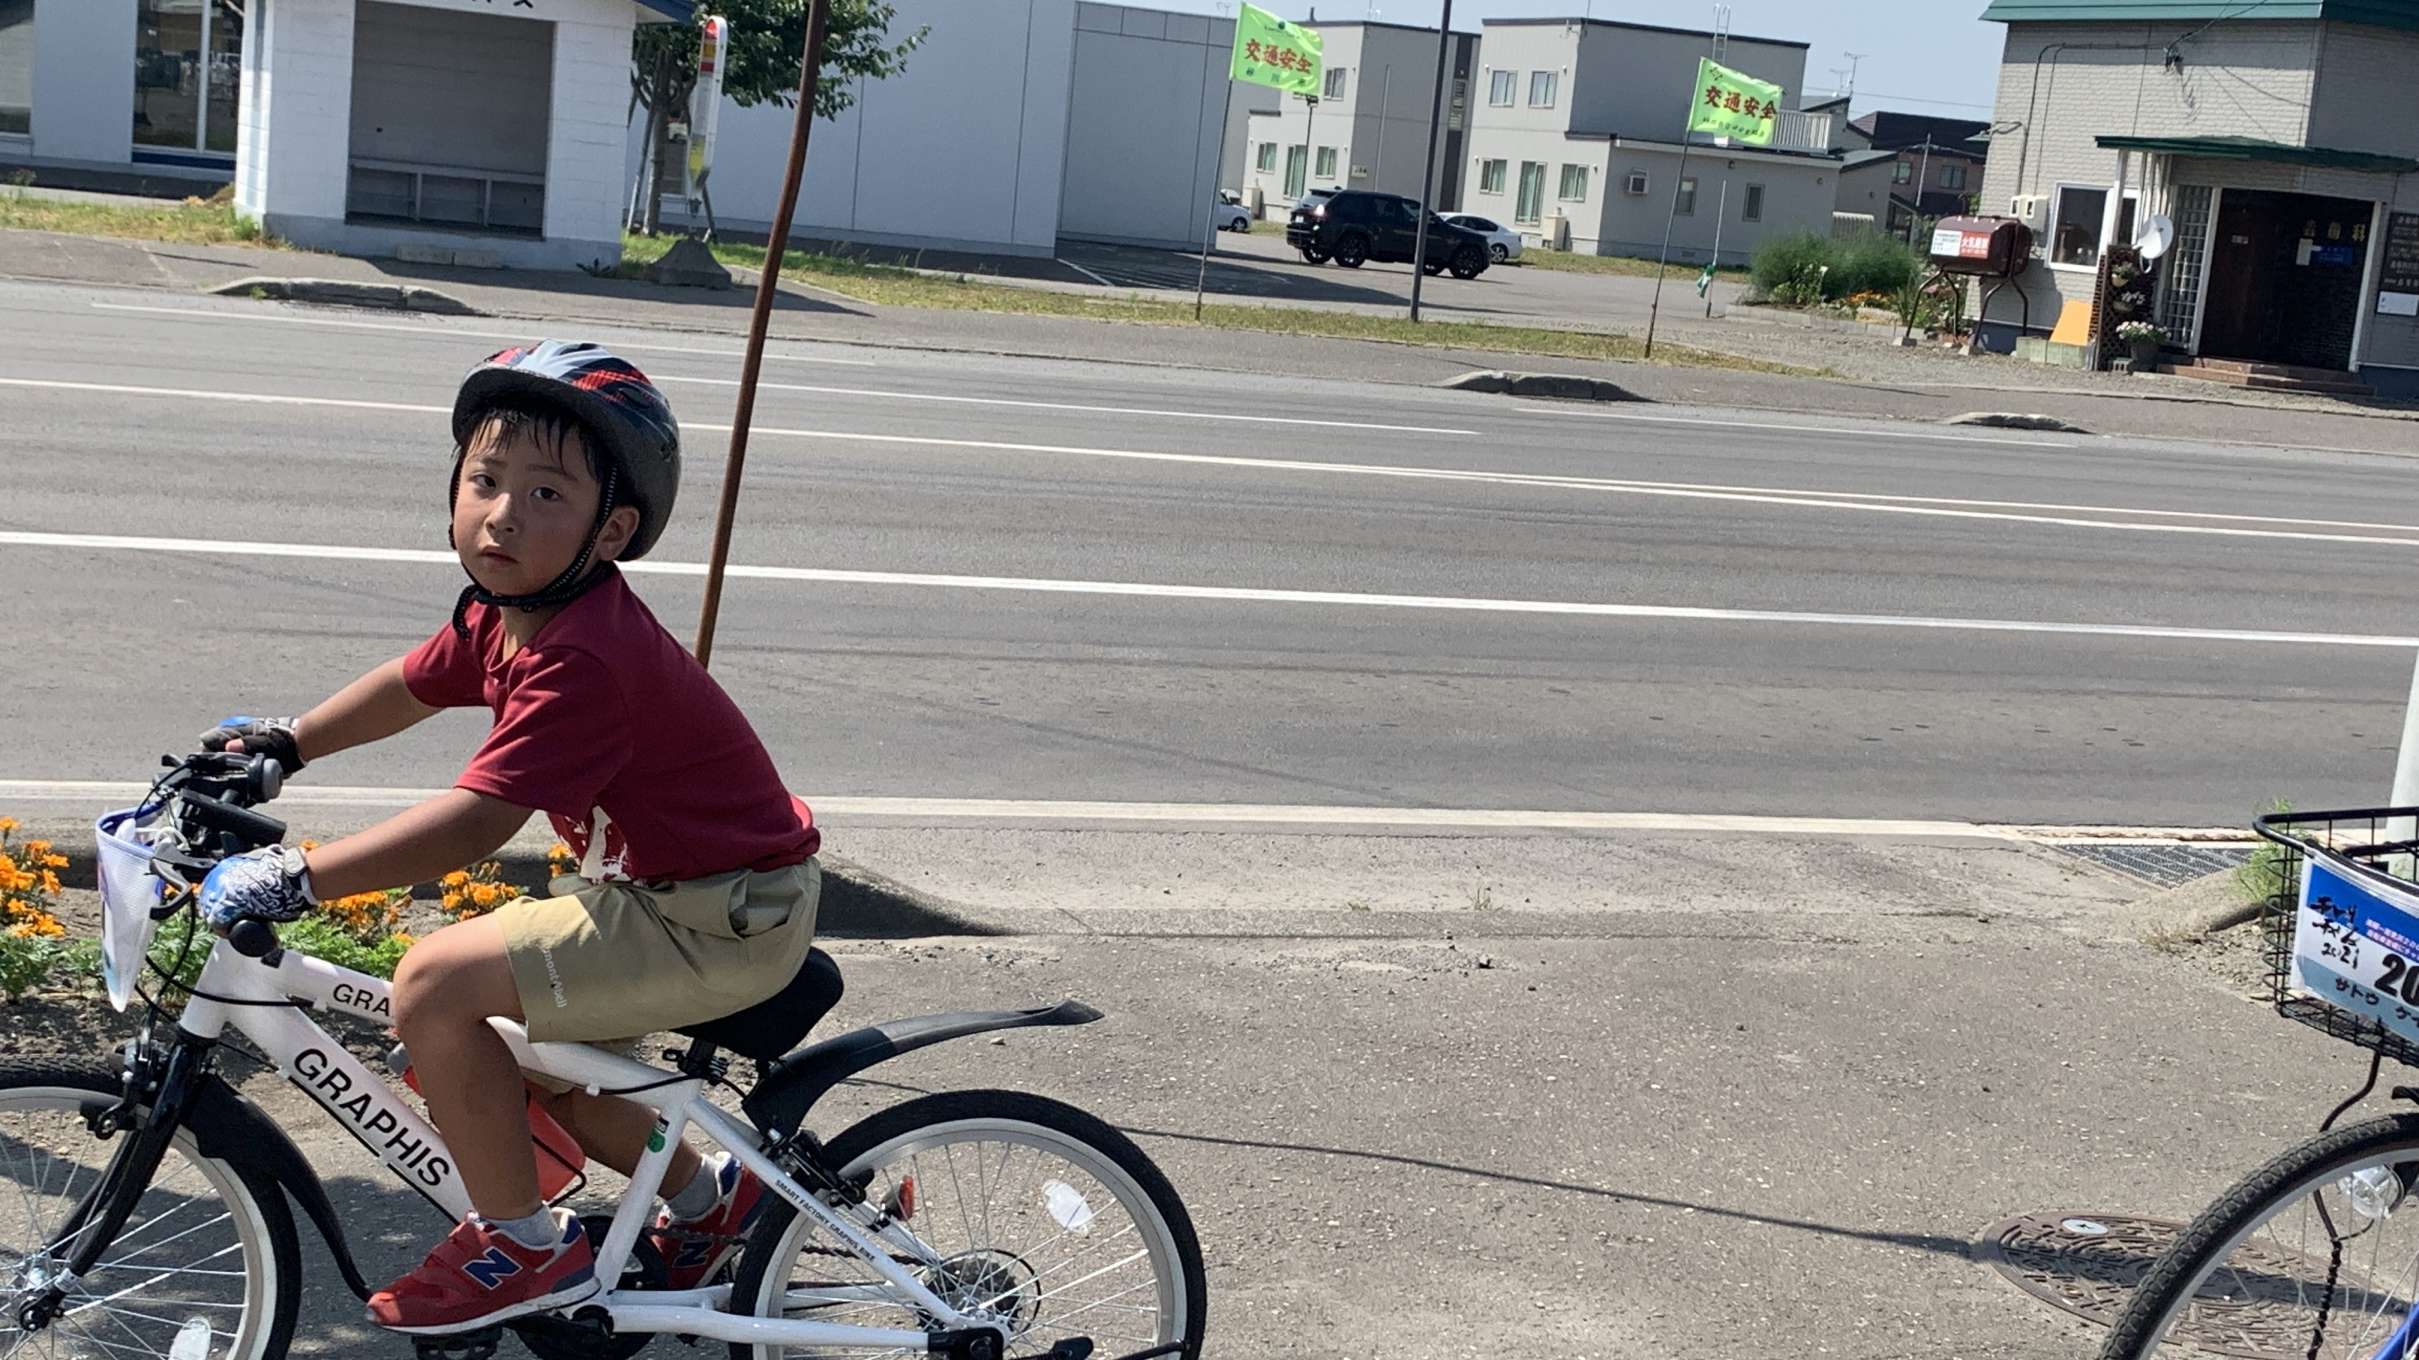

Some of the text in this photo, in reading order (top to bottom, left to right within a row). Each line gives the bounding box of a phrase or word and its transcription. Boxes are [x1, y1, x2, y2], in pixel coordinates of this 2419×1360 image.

[1243, 38, 1313, 74] 交通安全
[1703, 85, 1778, 119] 交通安全
[2335, 977, 2380, 1005] サトウ
[293, 1048, 450, 1187] GRAPHIS
[775, 1179, 801, 1201] SMART
[799, 1199, 831, 1225] FACTORY
[461, 1246, 523, 1290] N
